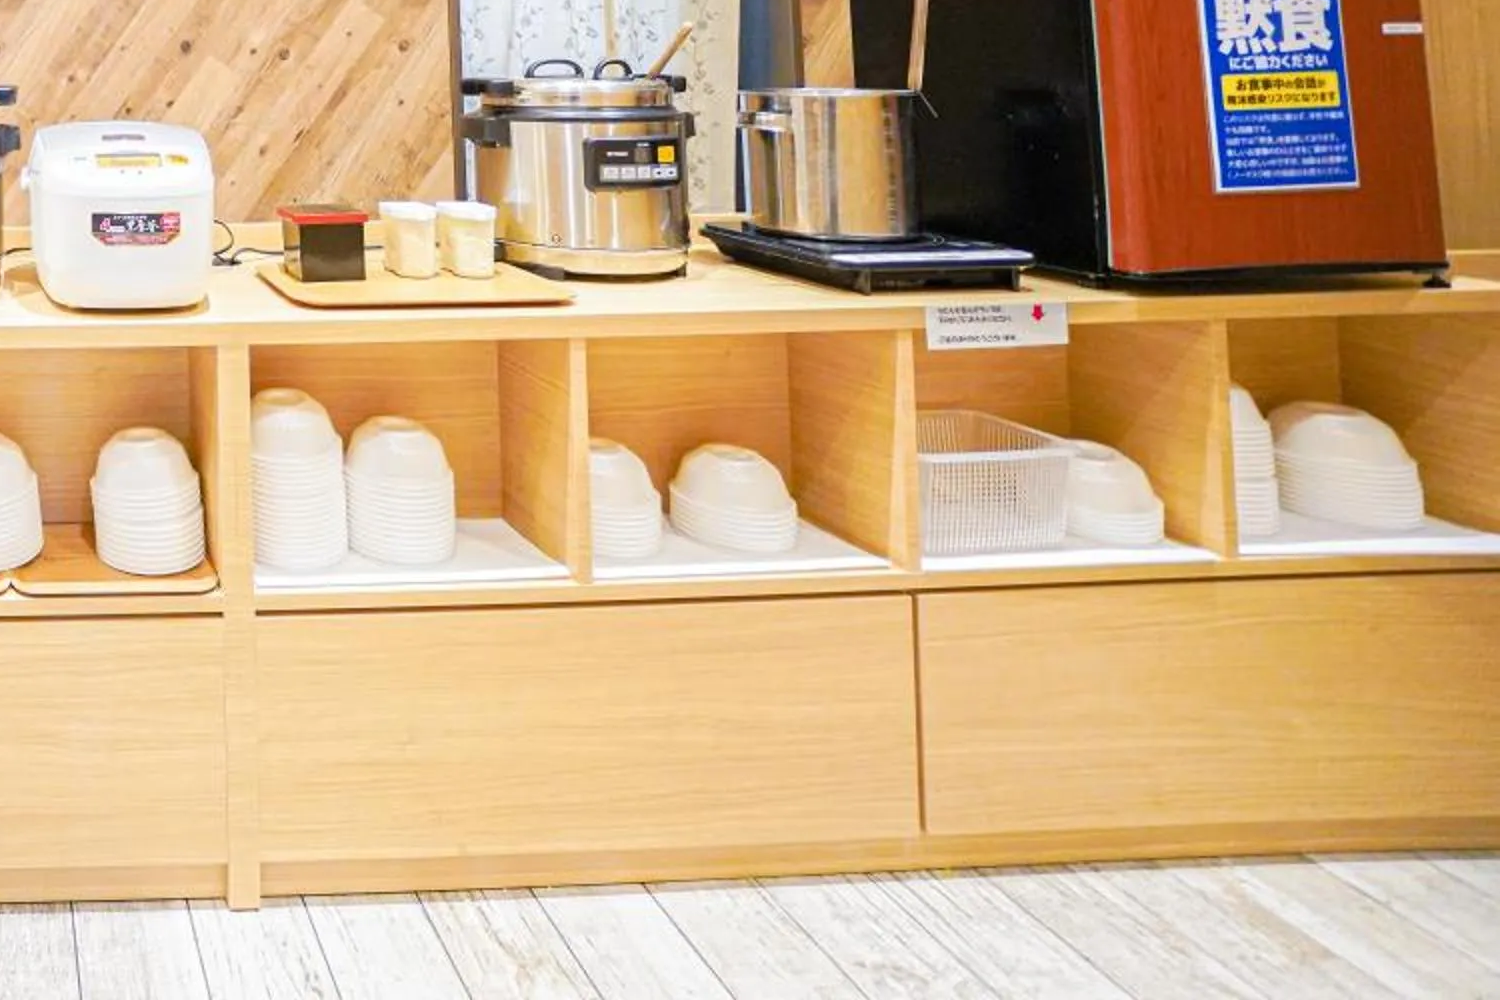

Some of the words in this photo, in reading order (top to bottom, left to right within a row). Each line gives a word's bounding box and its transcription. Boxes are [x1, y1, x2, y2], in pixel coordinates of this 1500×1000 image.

[1228, 53, 1329, 71] にご協力ください
